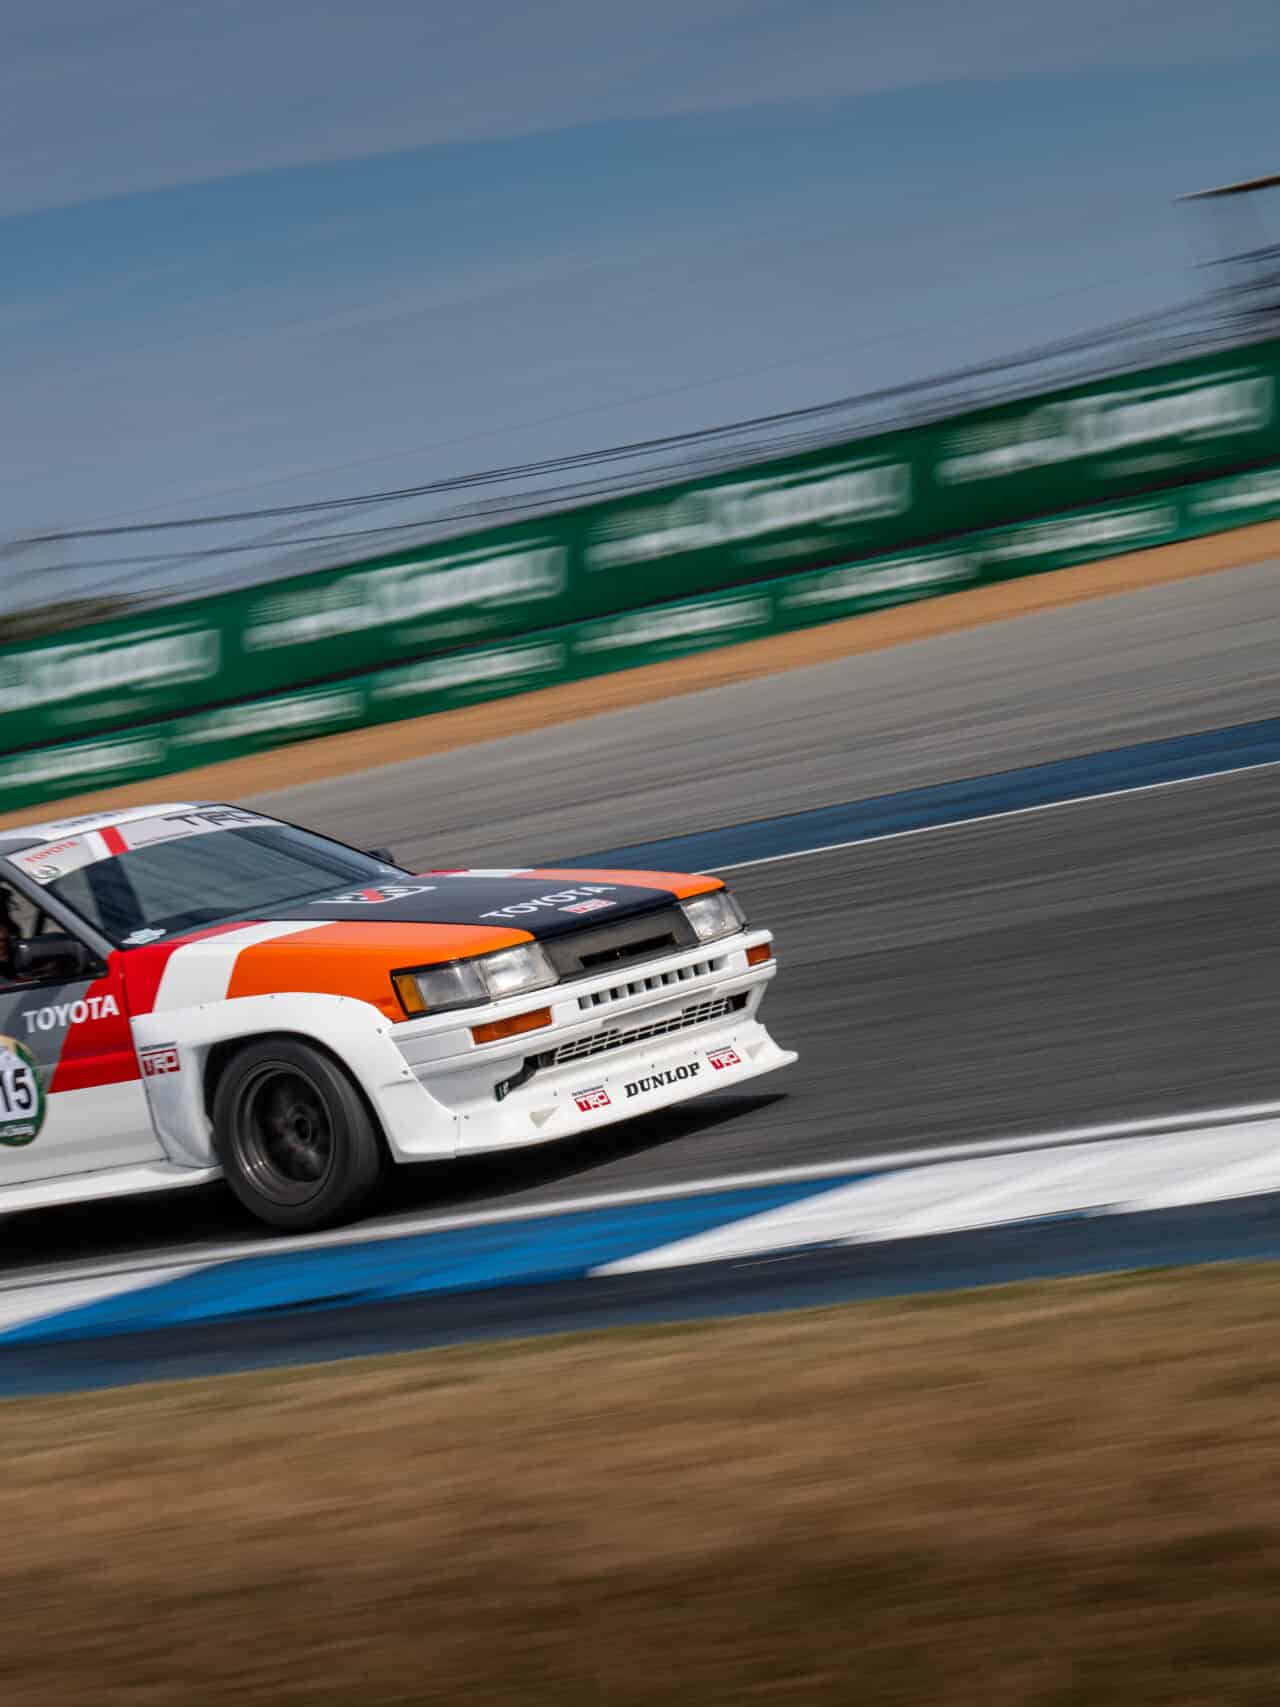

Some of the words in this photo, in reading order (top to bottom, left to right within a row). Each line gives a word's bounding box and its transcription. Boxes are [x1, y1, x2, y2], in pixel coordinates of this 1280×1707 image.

[479, 885, 617, 918] TOYOTA
[22, 994, 120, 1033] TOYOTA
[624, 1062, 700, 1098] DUNLOP
